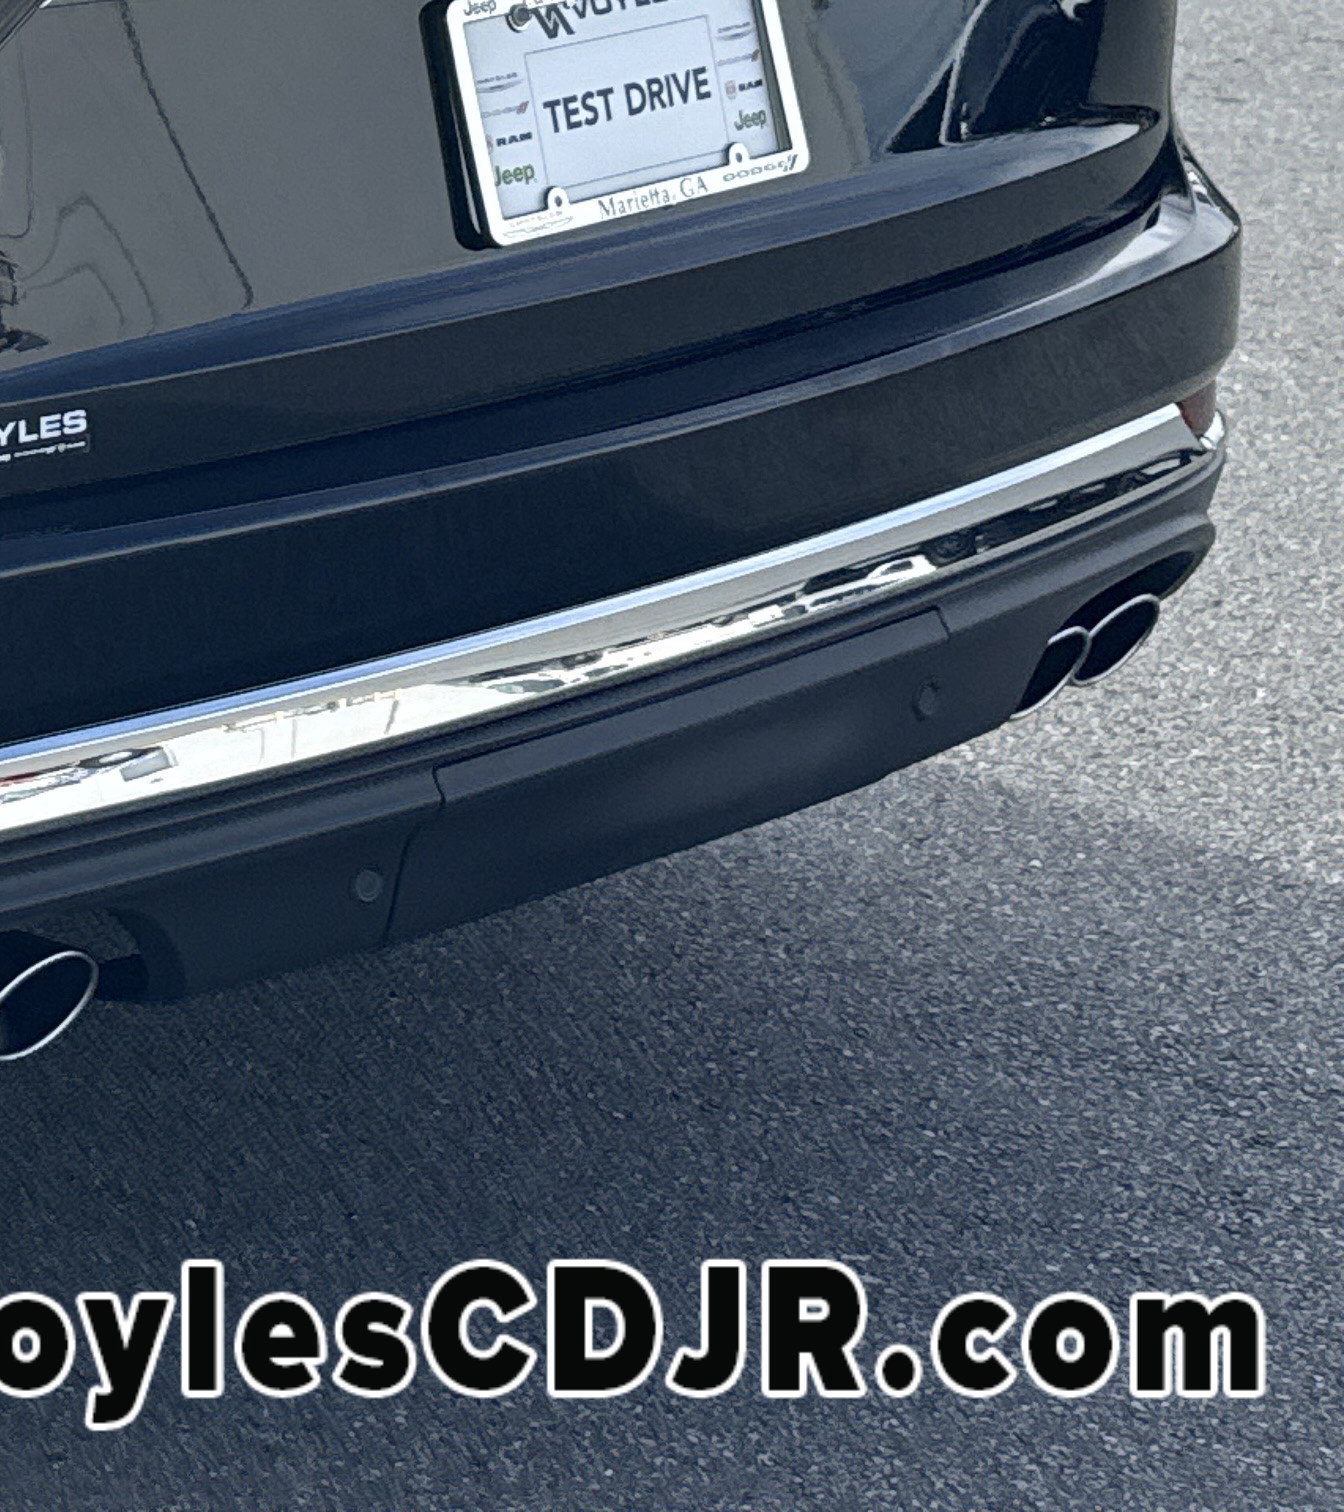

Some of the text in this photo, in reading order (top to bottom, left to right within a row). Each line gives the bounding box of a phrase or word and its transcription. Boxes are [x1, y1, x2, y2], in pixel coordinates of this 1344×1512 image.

[463, 0, 497, 16] Jeep
[542, 65, 712, 133] TEST DRIVE
[733, 109, 767, 131] Jeep
[495, 132, 533, 147] RAM
[494, 163, 535, 187] Jeep
[679, 176, 709, 198] GA
